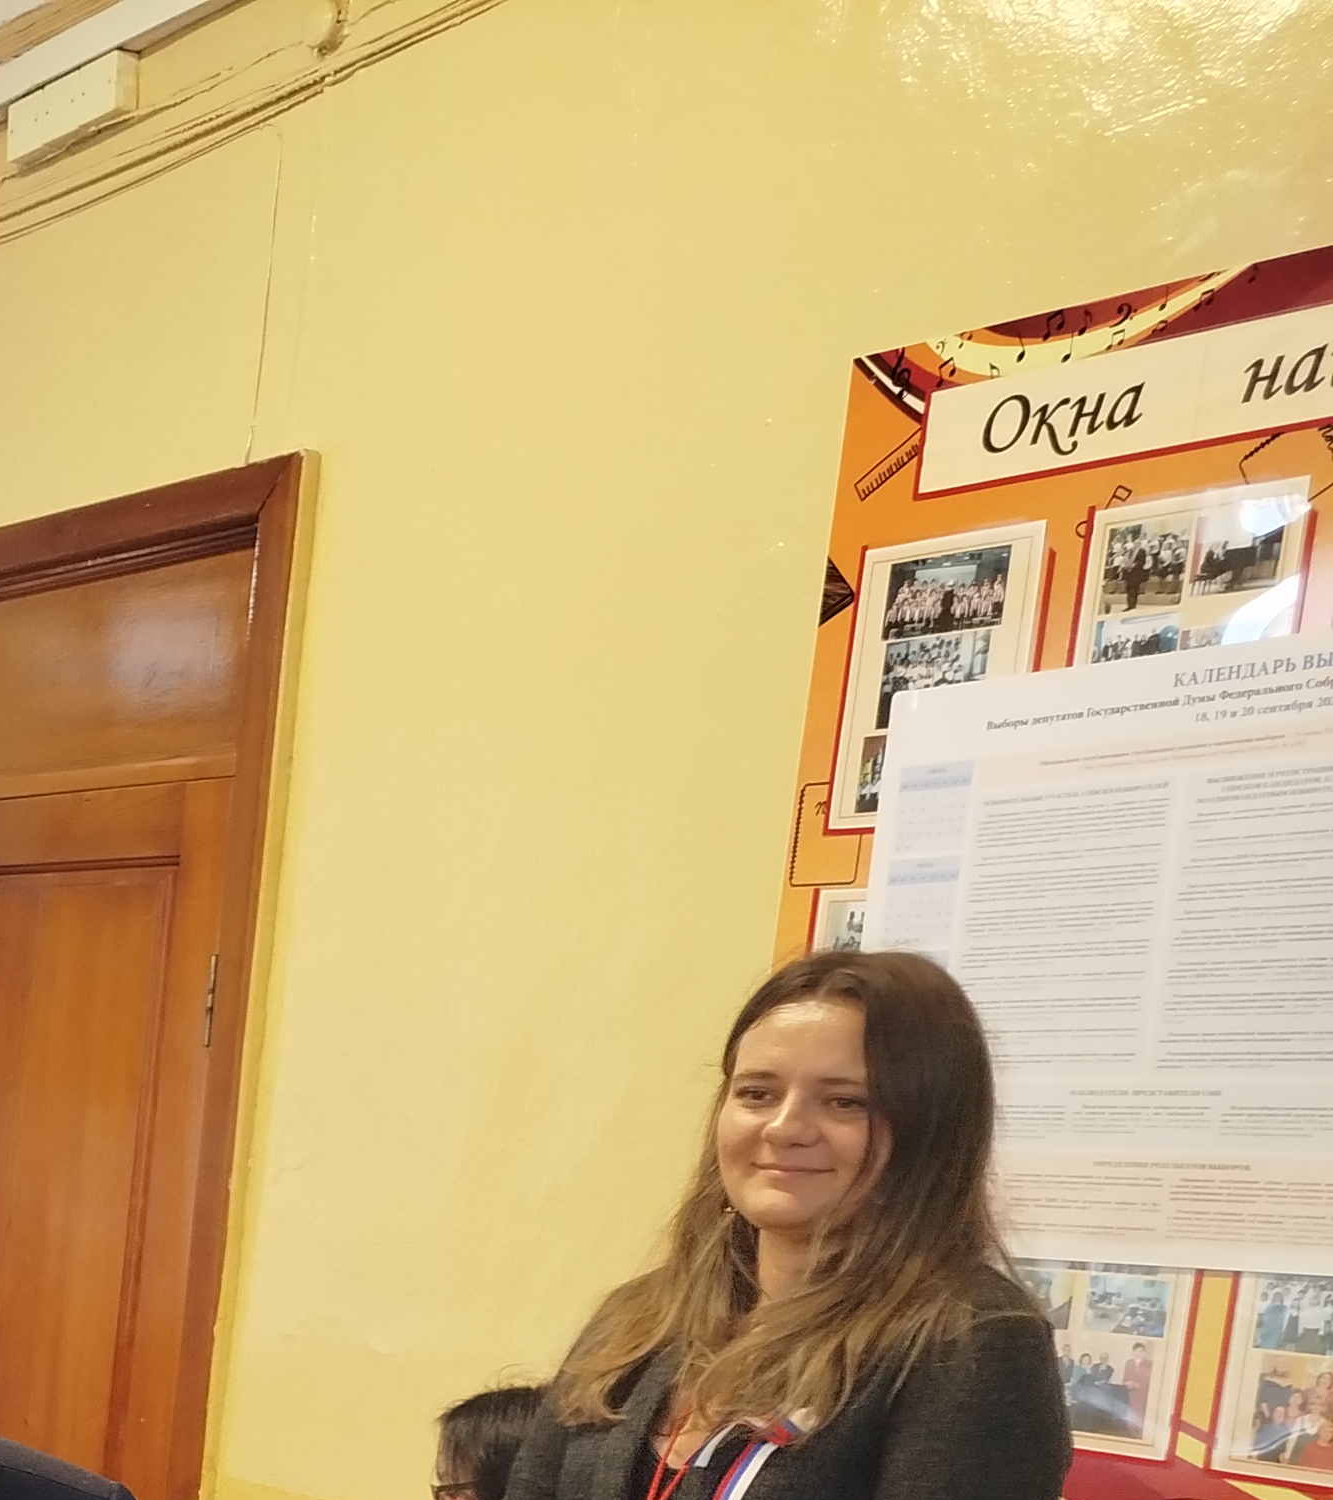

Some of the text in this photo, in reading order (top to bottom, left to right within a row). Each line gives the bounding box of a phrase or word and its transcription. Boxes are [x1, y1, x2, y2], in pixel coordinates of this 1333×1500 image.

[982, 342, 1333, 456] Окна на
[1173, 657, 1297, 688] КАЛЕНДАРЬ
[986, 718, 1029, 731] Выборы
[1031, 711, 1084, 727] депутатов
[1087, 696, 1180, 719] Государственной
[1182, 694, 1215, 708] Думы
[1219, 681, 1302, 701] Федерального
[1257, 697, 1313, 714] сентября
